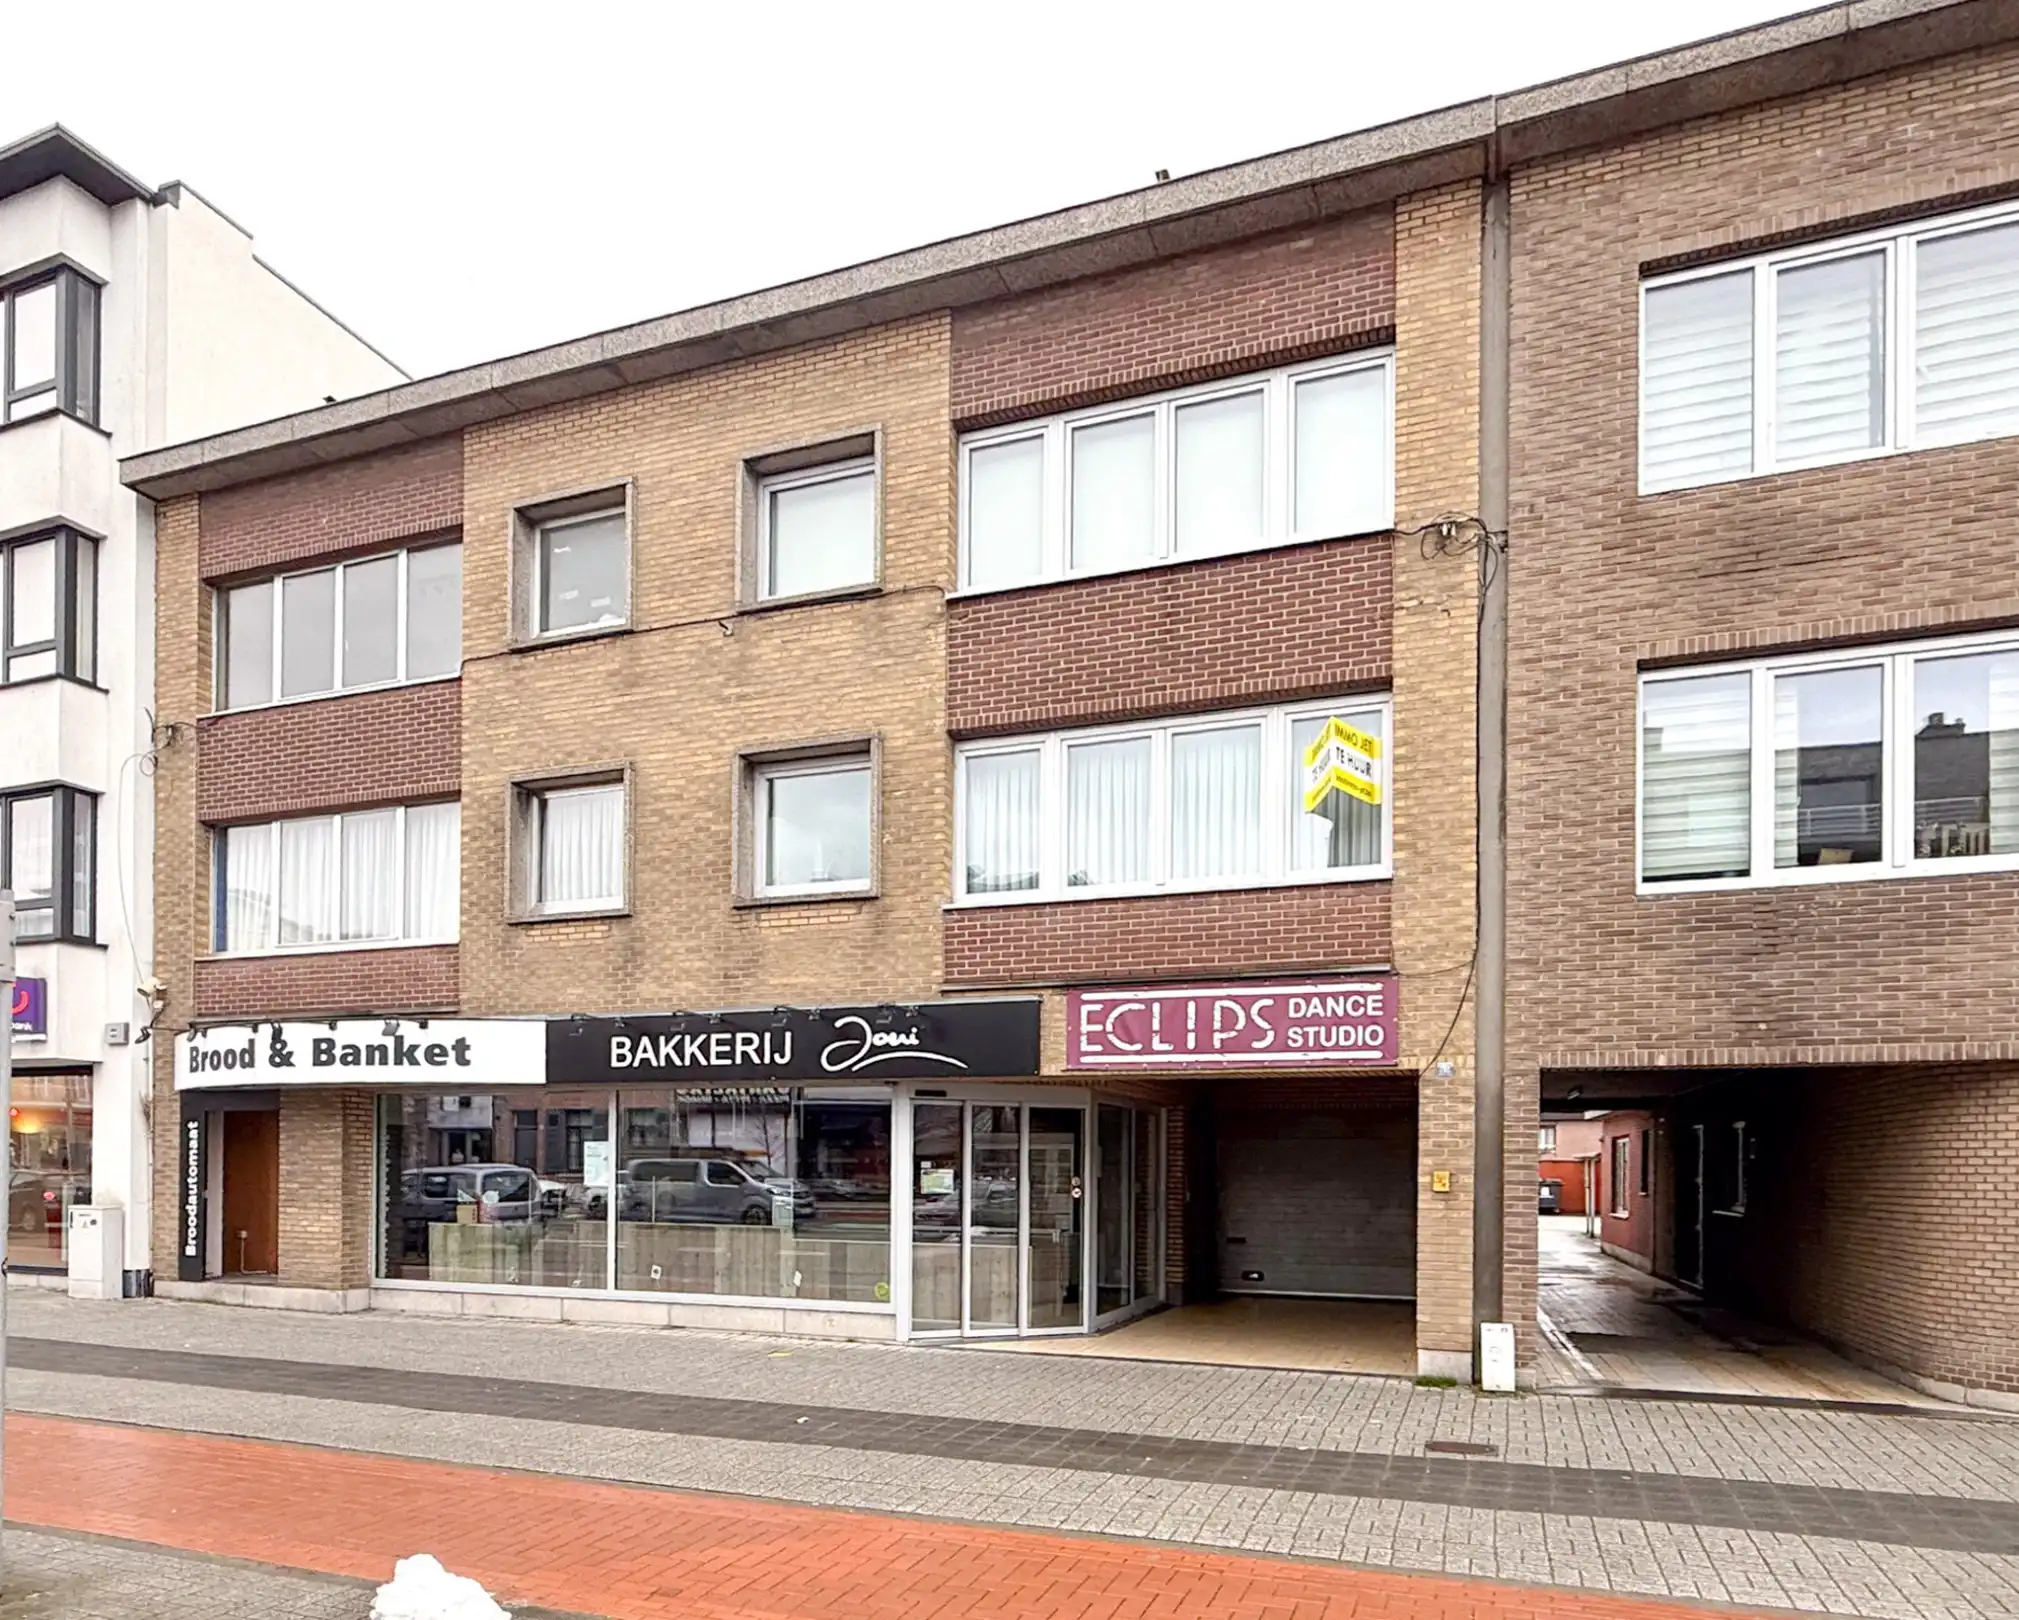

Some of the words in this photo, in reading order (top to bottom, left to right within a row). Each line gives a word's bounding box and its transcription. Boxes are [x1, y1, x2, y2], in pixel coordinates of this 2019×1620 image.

[1335, 723, 1358, 746] IMMO
[1336, 746, 1345, 764] TE
[1348, 752, 1371, 777] HUUR
[1287, 994, 1384, 1019] DANCE
[1080, 998, 1276, 1051] ECLIPS
[1286, 1023, 1385, 1049] STUDIO
[189, 1038, 256, 1074] Brood
[267, 1037, 297, 1068] &
[312, 1034, 472, 1067] Banket
[610, 1031, 793, 1068] BAKKERIJ
[184, 1120, 199, 1257] Broodautomaat
